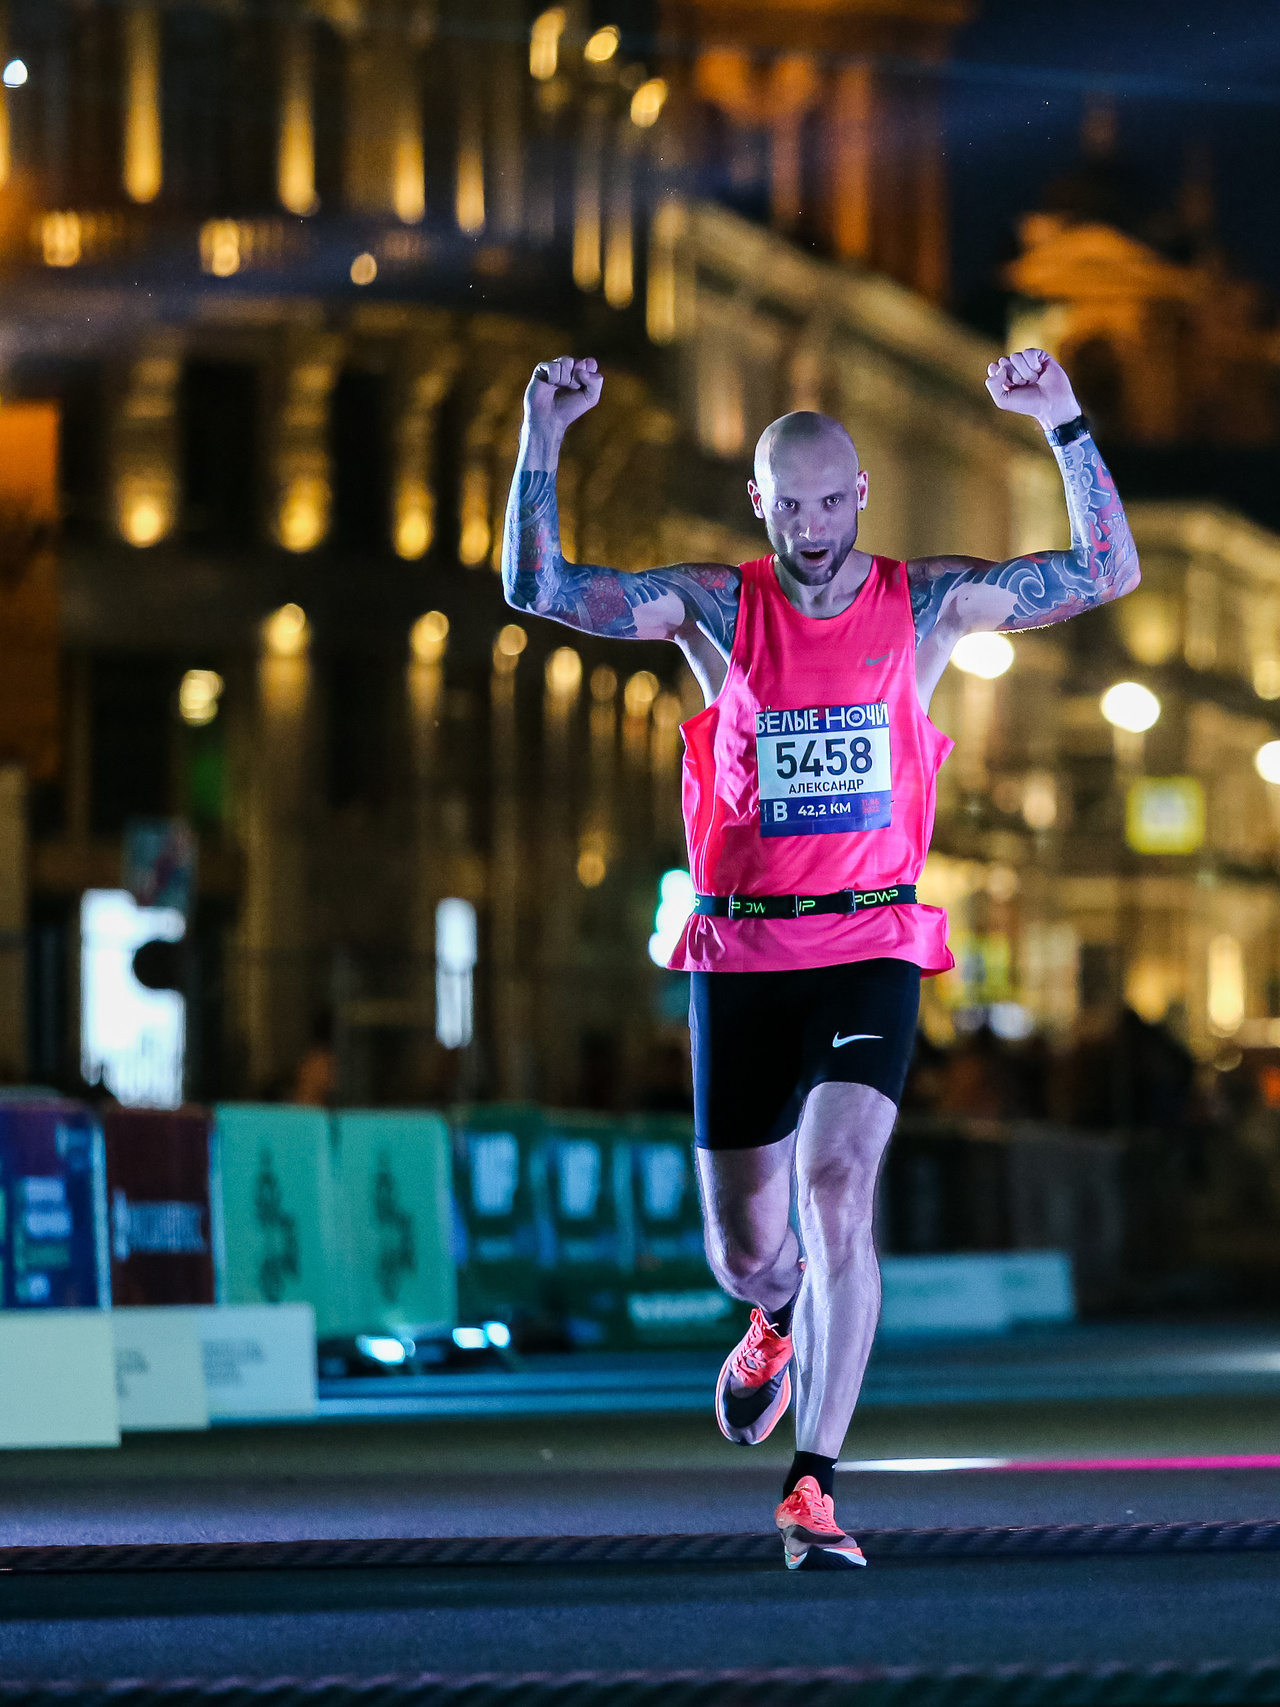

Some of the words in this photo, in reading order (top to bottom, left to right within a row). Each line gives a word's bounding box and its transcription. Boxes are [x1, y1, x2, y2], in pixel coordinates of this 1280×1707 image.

[756, 709, 820, 734] БЕЛЫЕ
[825, 704, 889, 729] НОЧИ
[776, 737, 873, 779] 5458
[789, 779, 864, 794] АЛЕКСАНДР
[798, 804, 827, 818] 42,2
